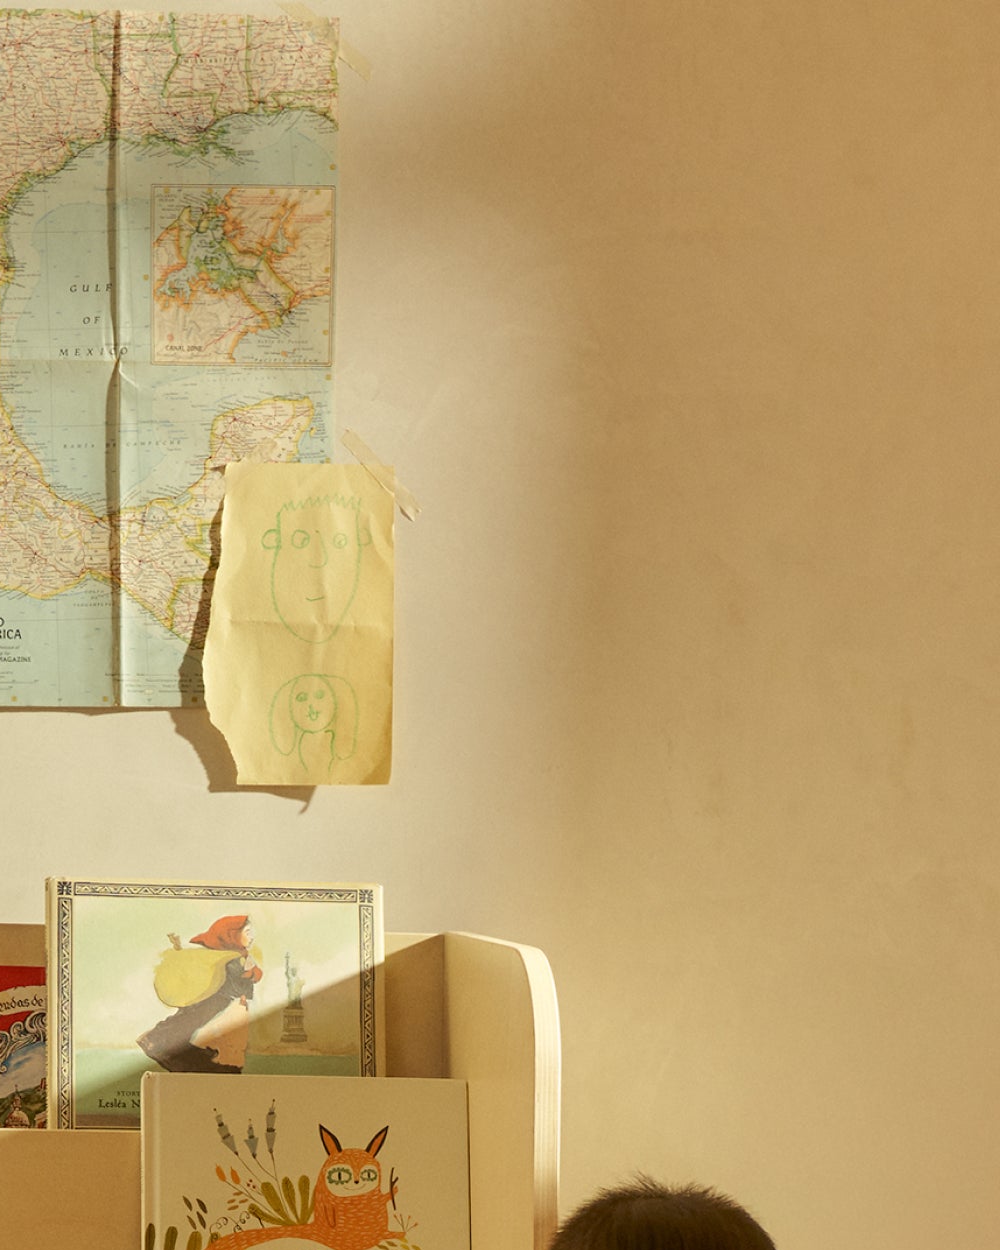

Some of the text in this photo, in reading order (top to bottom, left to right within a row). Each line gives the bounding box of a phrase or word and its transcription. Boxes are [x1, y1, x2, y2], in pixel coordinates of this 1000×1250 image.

[69, 283, 113, 293] GULF
[82, 316, 101, 325] OF
[58, 346, 128, 357] MEXICO
[31, 994, 43, 1007] de
